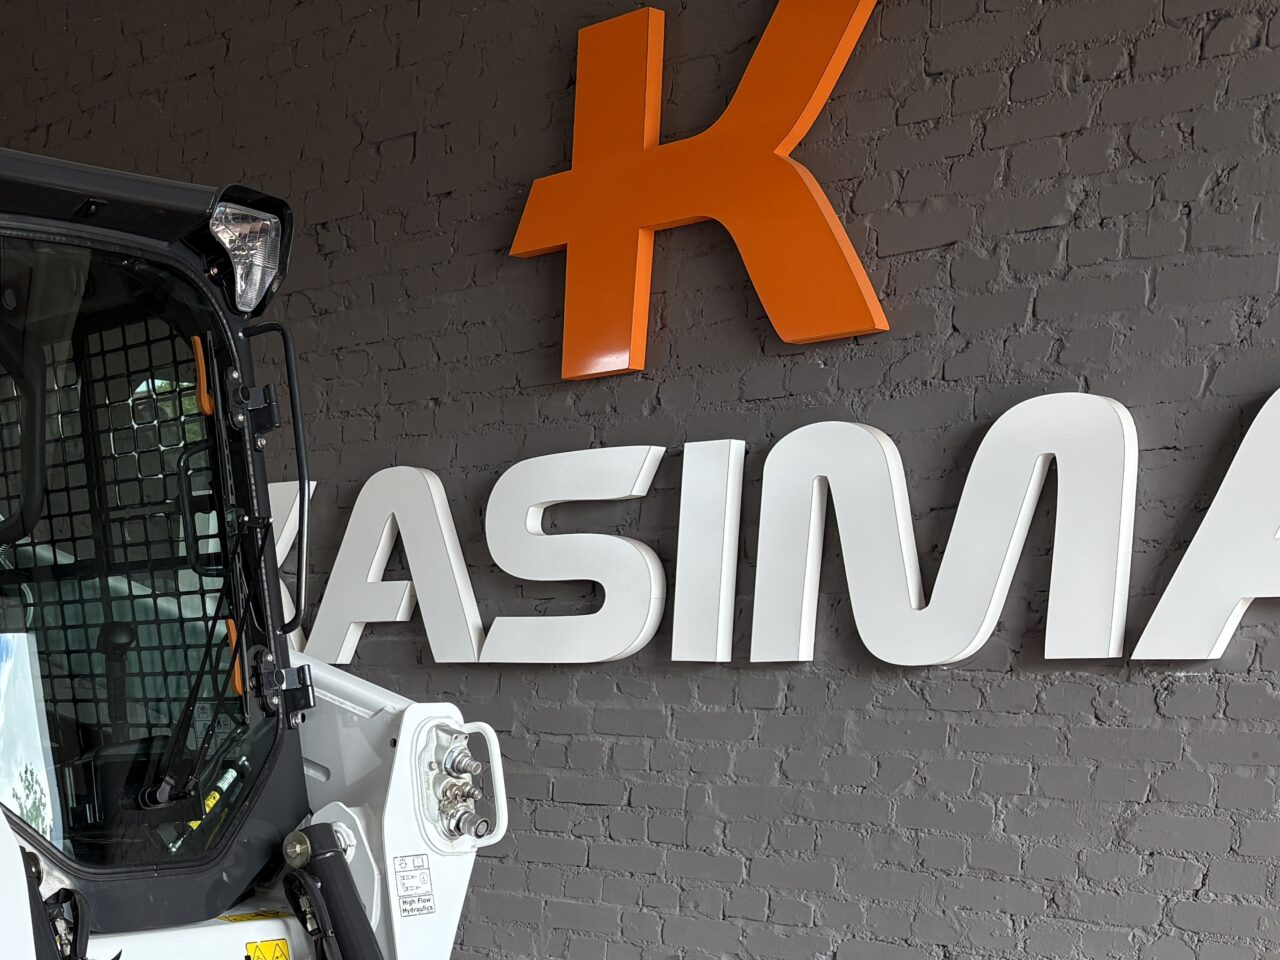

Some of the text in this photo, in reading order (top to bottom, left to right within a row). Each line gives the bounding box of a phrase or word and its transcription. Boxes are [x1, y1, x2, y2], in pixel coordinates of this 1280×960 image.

[510, 0, 888, 380] K
[402, 897, 432, 907] High Flow
[402, 905, 434, 914] Hydraulics
